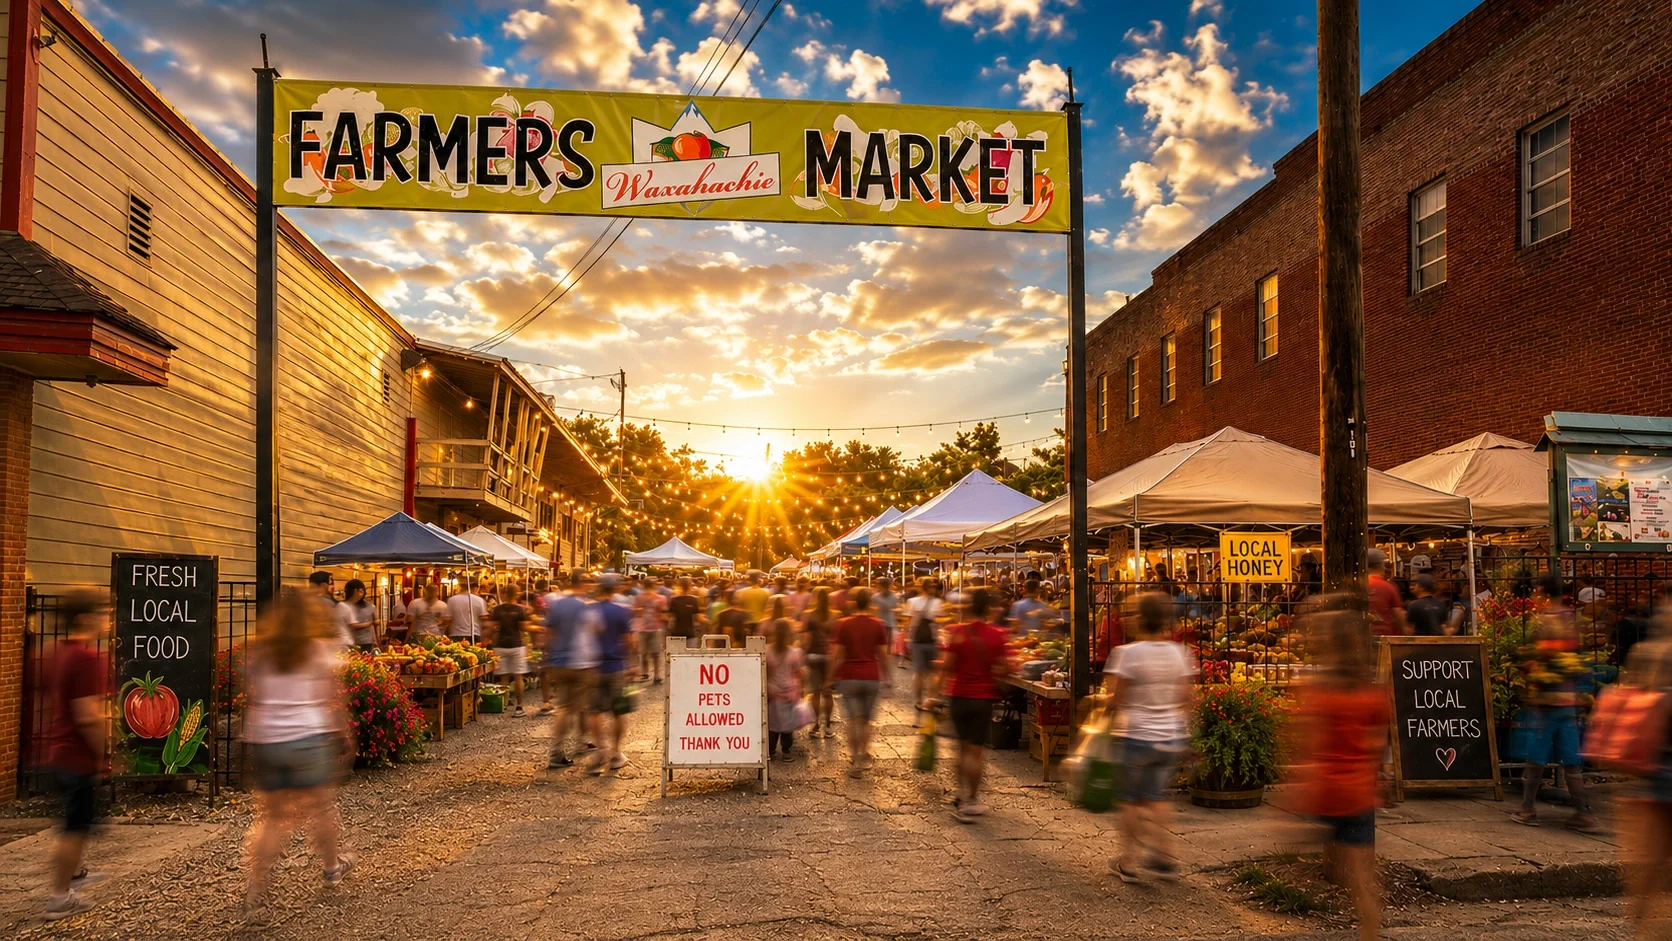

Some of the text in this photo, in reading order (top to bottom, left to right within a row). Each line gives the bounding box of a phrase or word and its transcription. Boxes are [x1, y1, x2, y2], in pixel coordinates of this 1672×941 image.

[290, 110, 1046, 206] FARMERS MARKET
[606, 162, 777, 203] Waxahachie
[1229, 540, 1282, 557] LOCAL
[132, 564, 197, 588] FRESH
[1227, 559, 1284, 576] HONEY
[131, 598, 197, 623] LOCAL
[134, 635, 190, 660] FOOD
[699, 663, 730, 686] NO
[1402, 659, 1474, 680] SUPPORT
[698, 693, 731, 706] PETS
[1414, 689, 1467, 709] LOCAL
[685, 712, 745, 726] ALLOWED
[1407, 718, 1481, 738] FARMERS
[679, 736, 750, 750] THANK YOU
